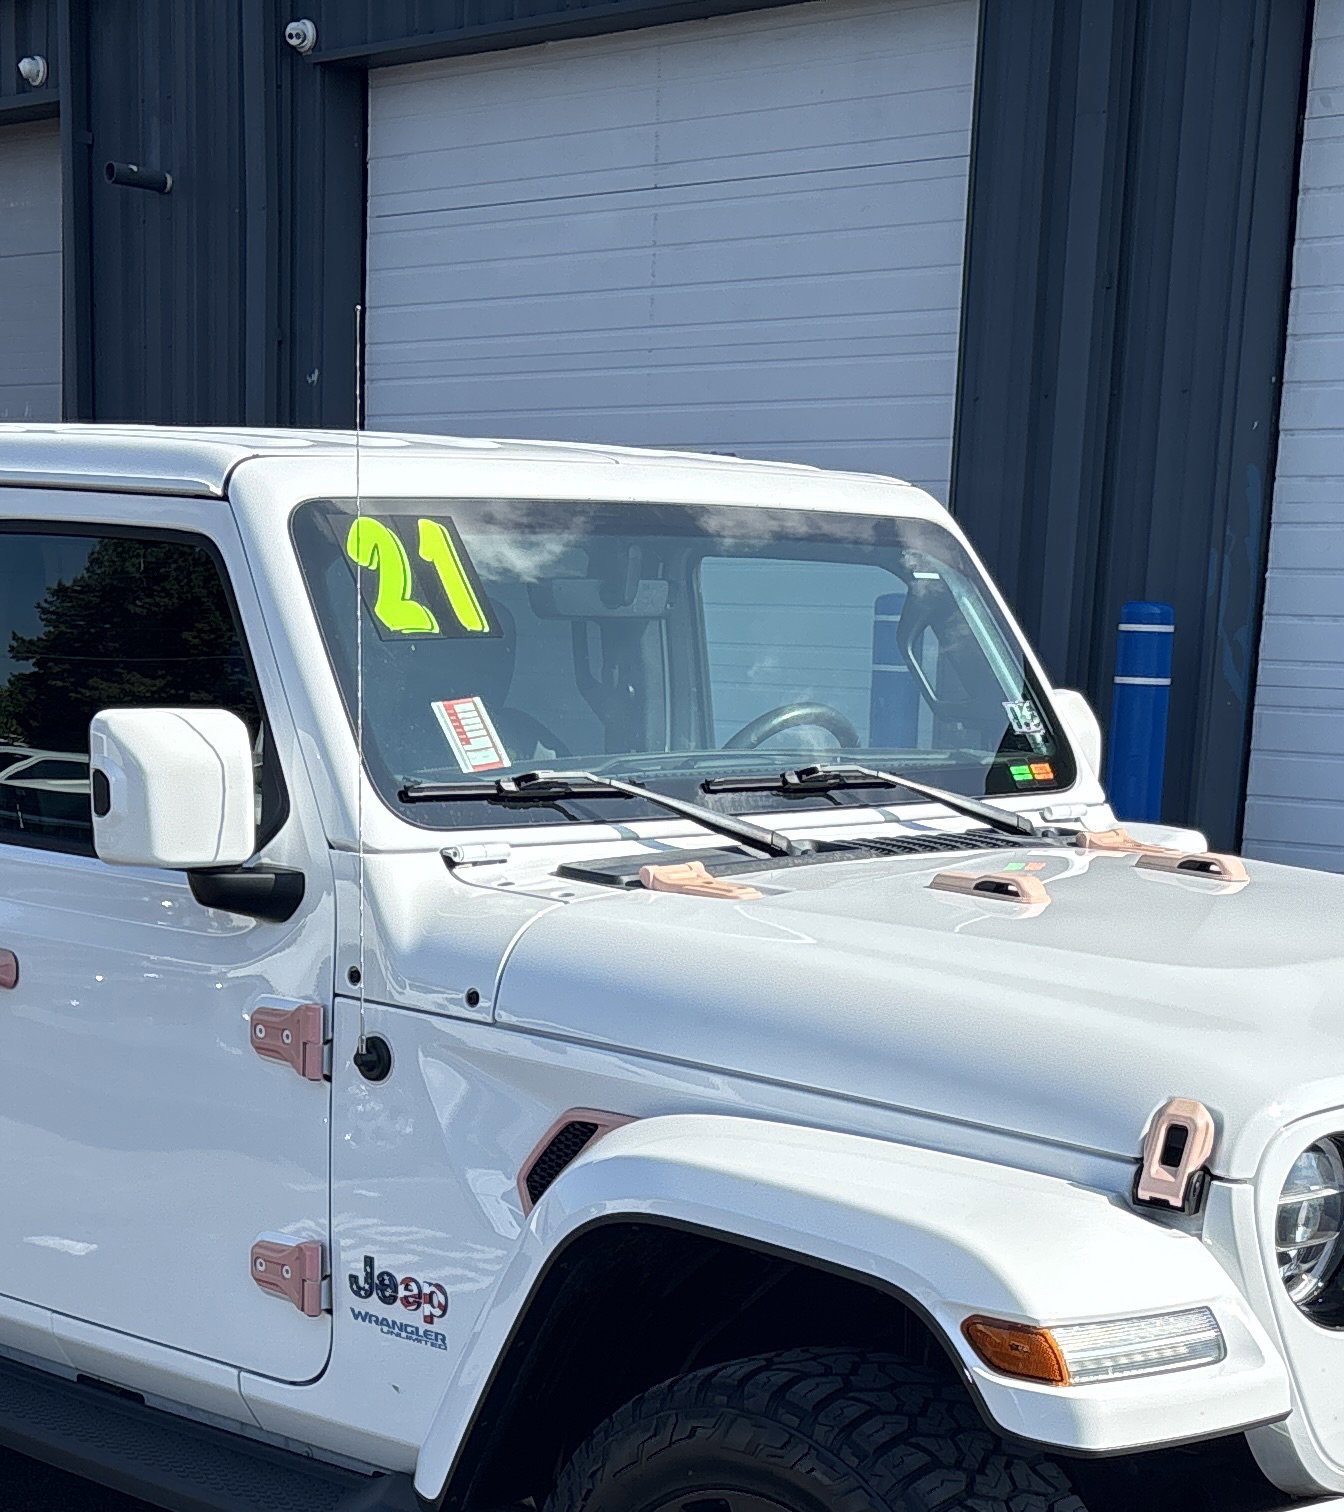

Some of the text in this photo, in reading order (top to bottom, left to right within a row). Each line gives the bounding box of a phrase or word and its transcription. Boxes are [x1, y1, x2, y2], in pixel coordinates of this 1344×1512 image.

[346, 516, 490, 634] 21
[348, 1254, 449, 1325] Jeep
[349, 1306, 448, 1344] WRANGLER
[379, 1326, 449, 1352] UNLIMITED
